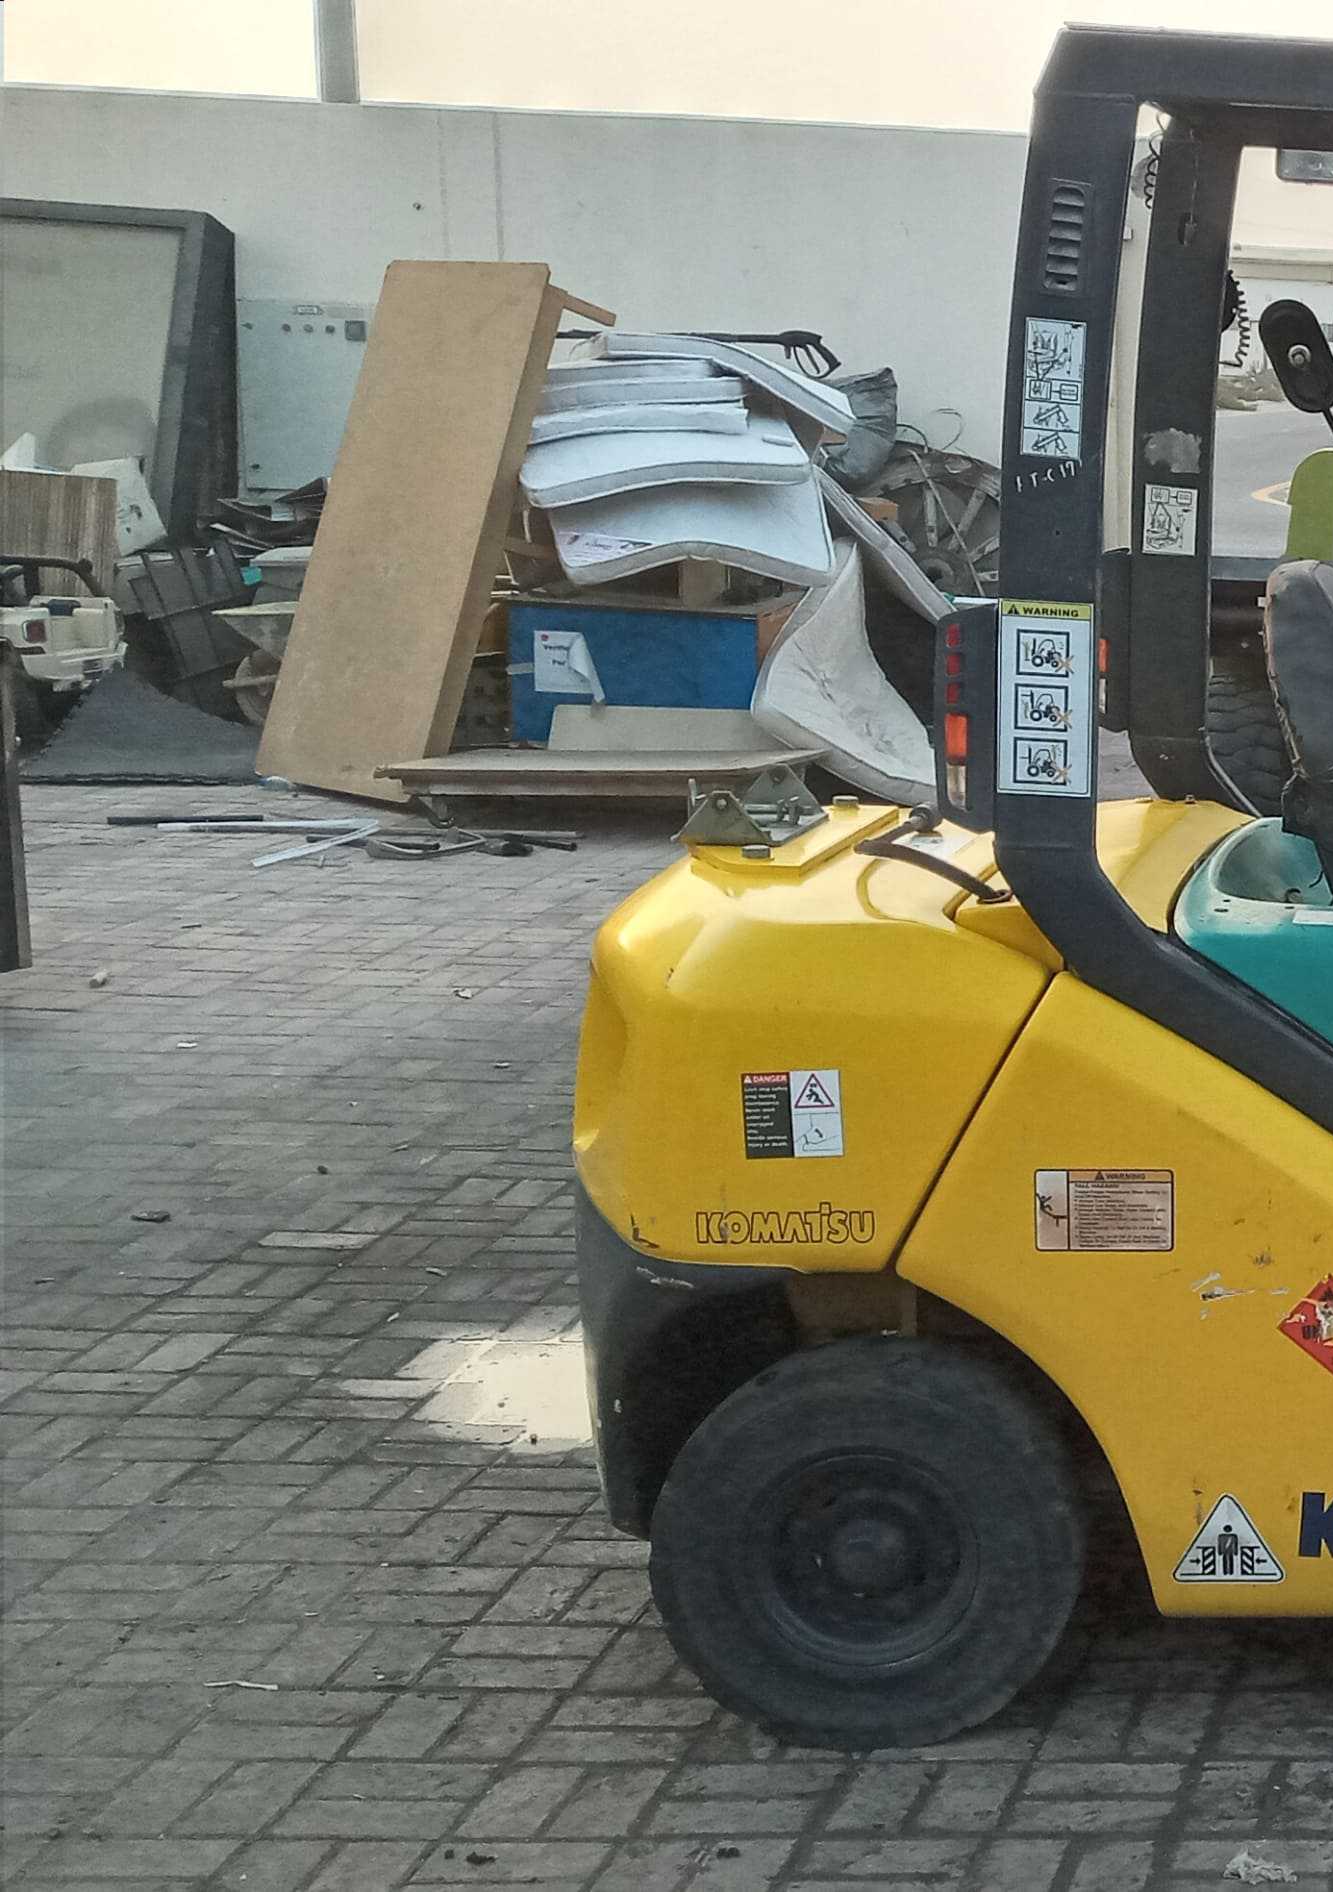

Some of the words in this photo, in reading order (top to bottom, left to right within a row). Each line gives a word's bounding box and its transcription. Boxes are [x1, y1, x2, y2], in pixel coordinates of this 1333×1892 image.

[1023, 606, 1079, 618] WARNING
[753, 1074, 787, 1083] DANGER
[1106, 1172, 1146, 1180] WARNING
[696, 1202, 875, 1244] KOMATSU
